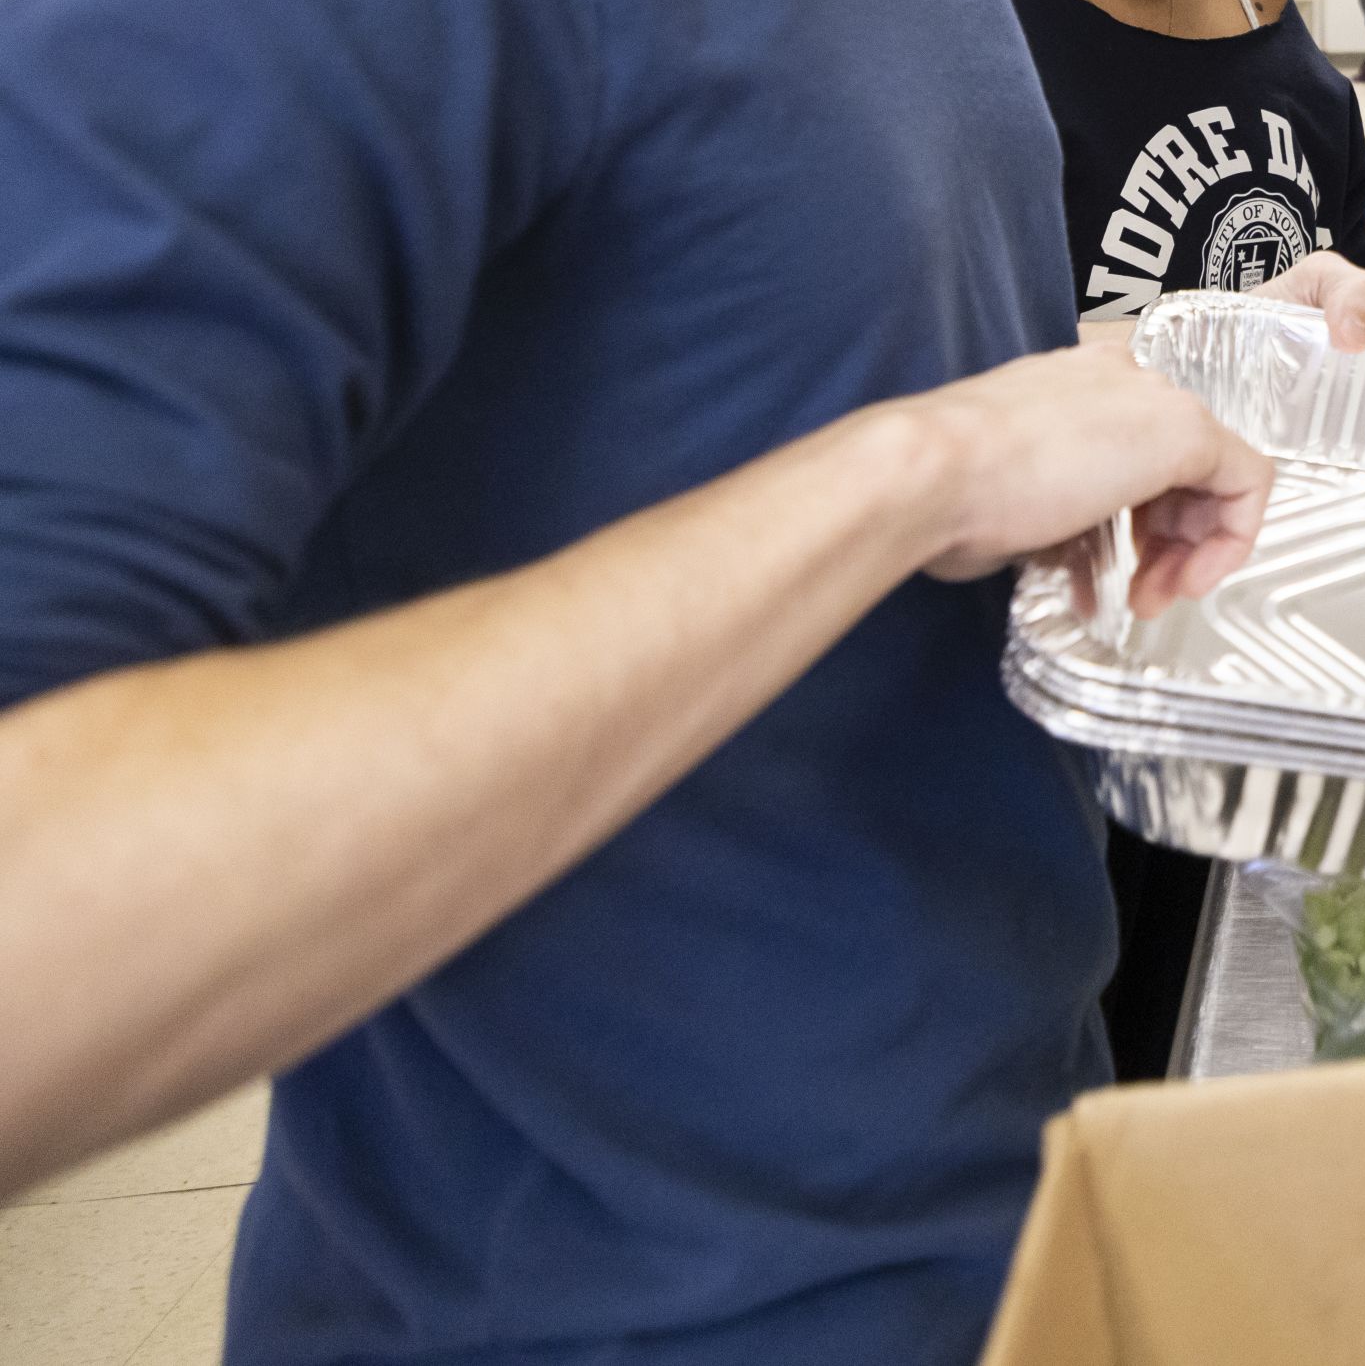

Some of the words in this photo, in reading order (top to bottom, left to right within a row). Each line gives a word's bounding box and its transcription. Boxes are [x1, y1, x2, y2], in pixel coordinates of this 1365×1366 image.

[1079, 105, 1253, 320] NOTRE
[1242, 204, 1264, 221] OF
[1269, 207, 1304, 261] NOTR
